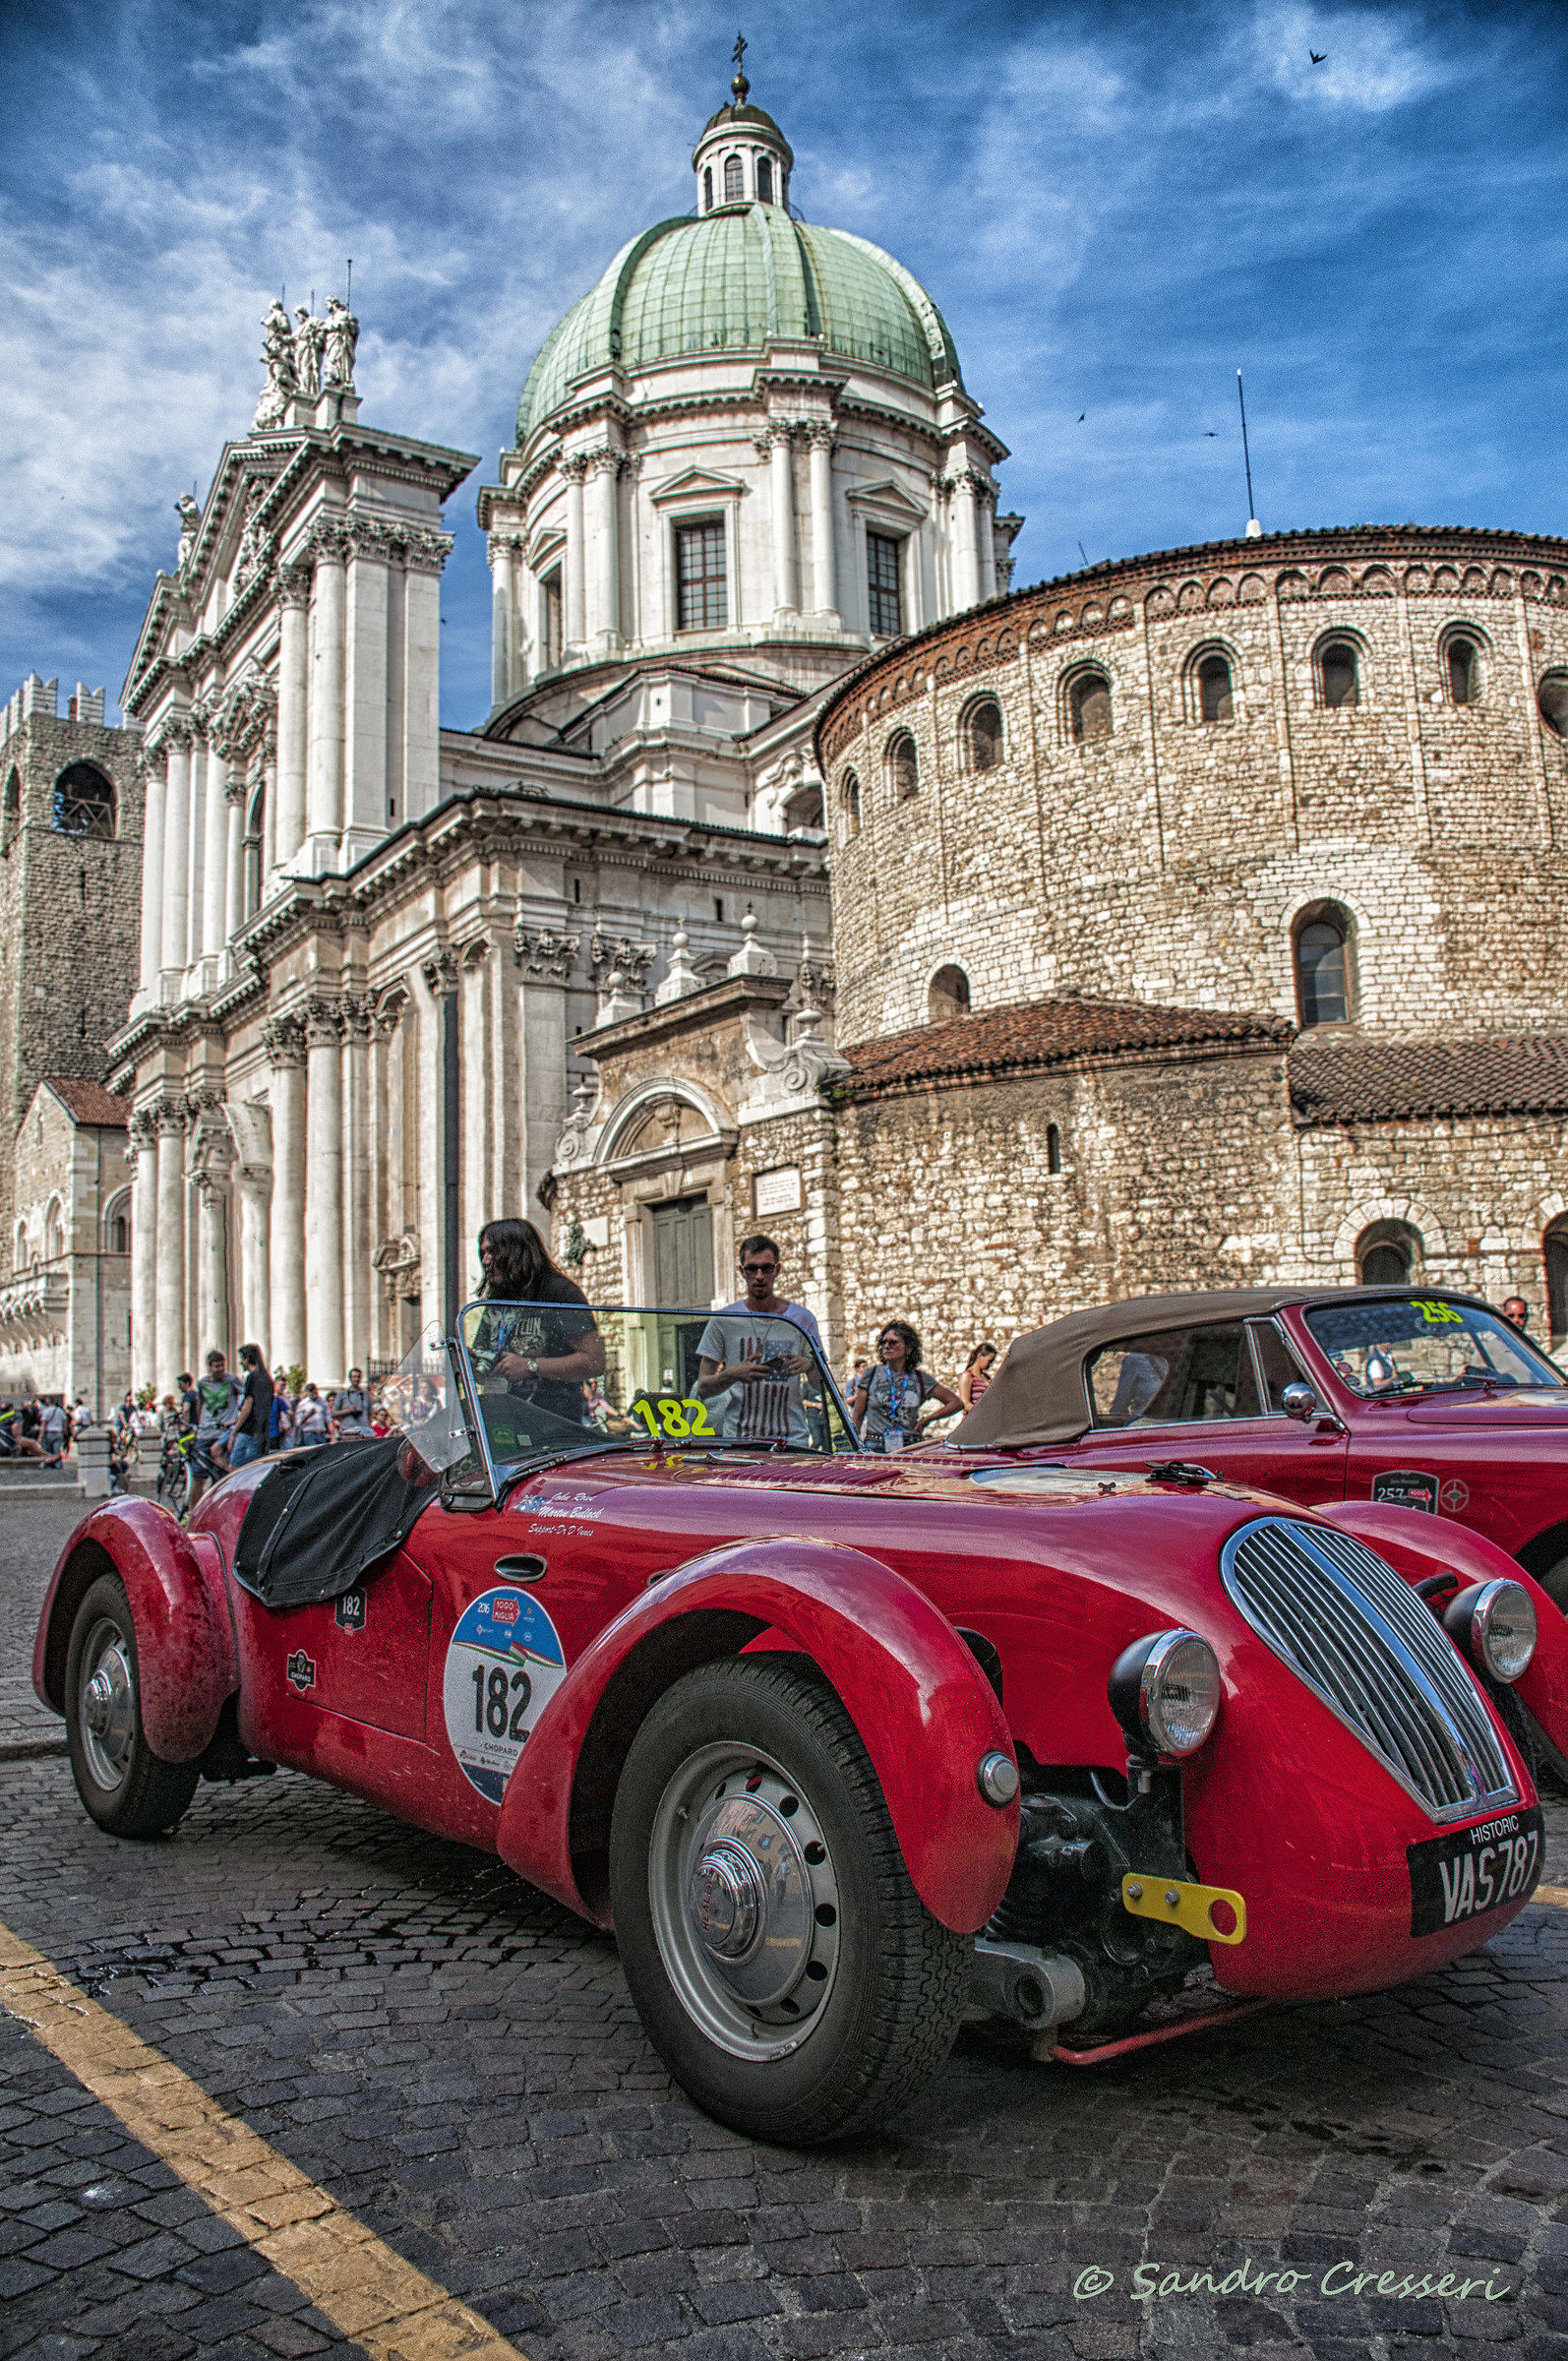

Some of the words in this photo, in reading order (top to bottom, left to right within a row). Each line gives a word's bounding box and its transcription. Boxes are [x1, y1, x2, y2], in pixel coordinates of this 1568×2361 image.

[1410, 1301, 1464, 1323] 256
[633, 1399, 716, 1437] 182
[1377, 1487, 1405, 1501] 257
[342, 1596, 360, 1616] 182
[494, 1611, 514, 1620] MIGLIA
[496, 1601, 514, 1610] 1000
[472, 1665, 531, 1743] 182
[484, 1742, 518, 1757] CHOPARD
[1471, 1814, 1519, 1846] HISTORIC
